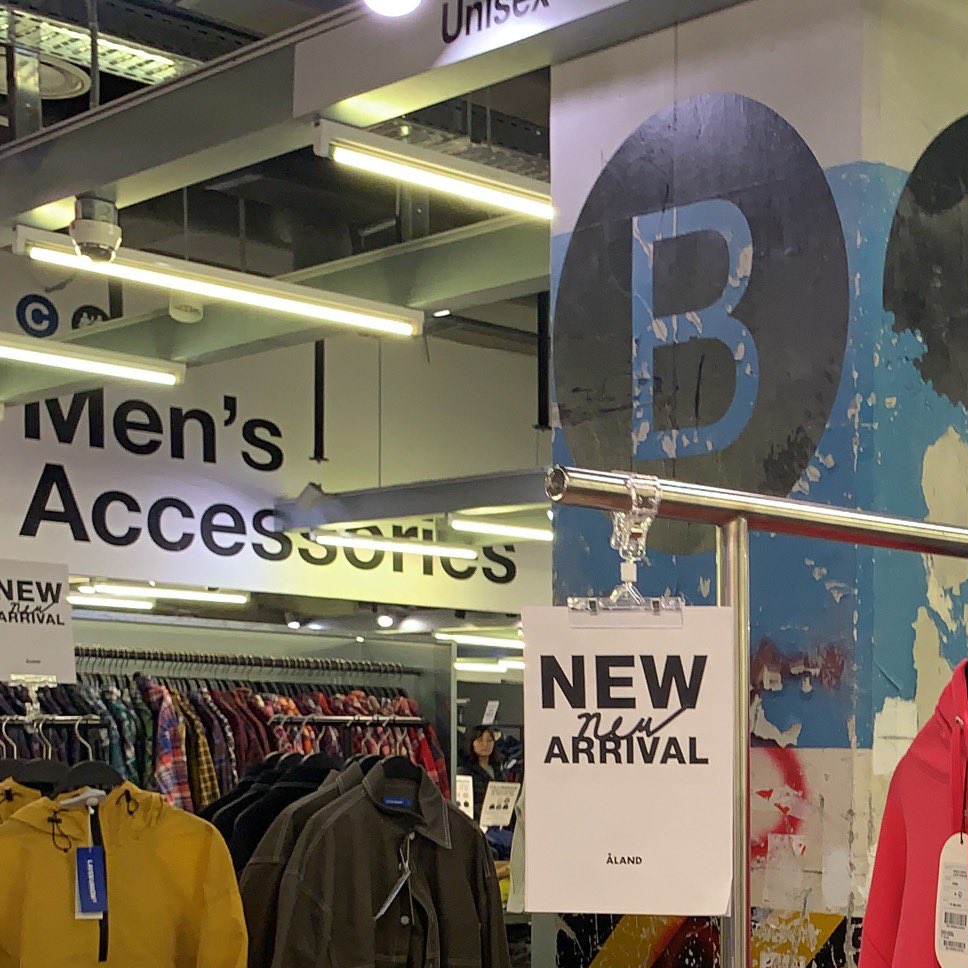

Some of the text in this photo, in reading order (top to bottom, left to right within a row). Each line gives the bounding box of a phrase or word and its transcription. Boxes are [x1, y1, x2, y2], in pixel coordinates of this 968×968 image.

[632, 199, 759, 461] B
[24, 387, 284, 472] Men’s
[0, 579, 62, 603] NEW
[0, 611, 65, 626] ARRIVAL
[540, 655, 708, 709] NEW
[543, 736, 709, 764] ARRIVAL
[606, 852, 642, 865] ÅLAND
